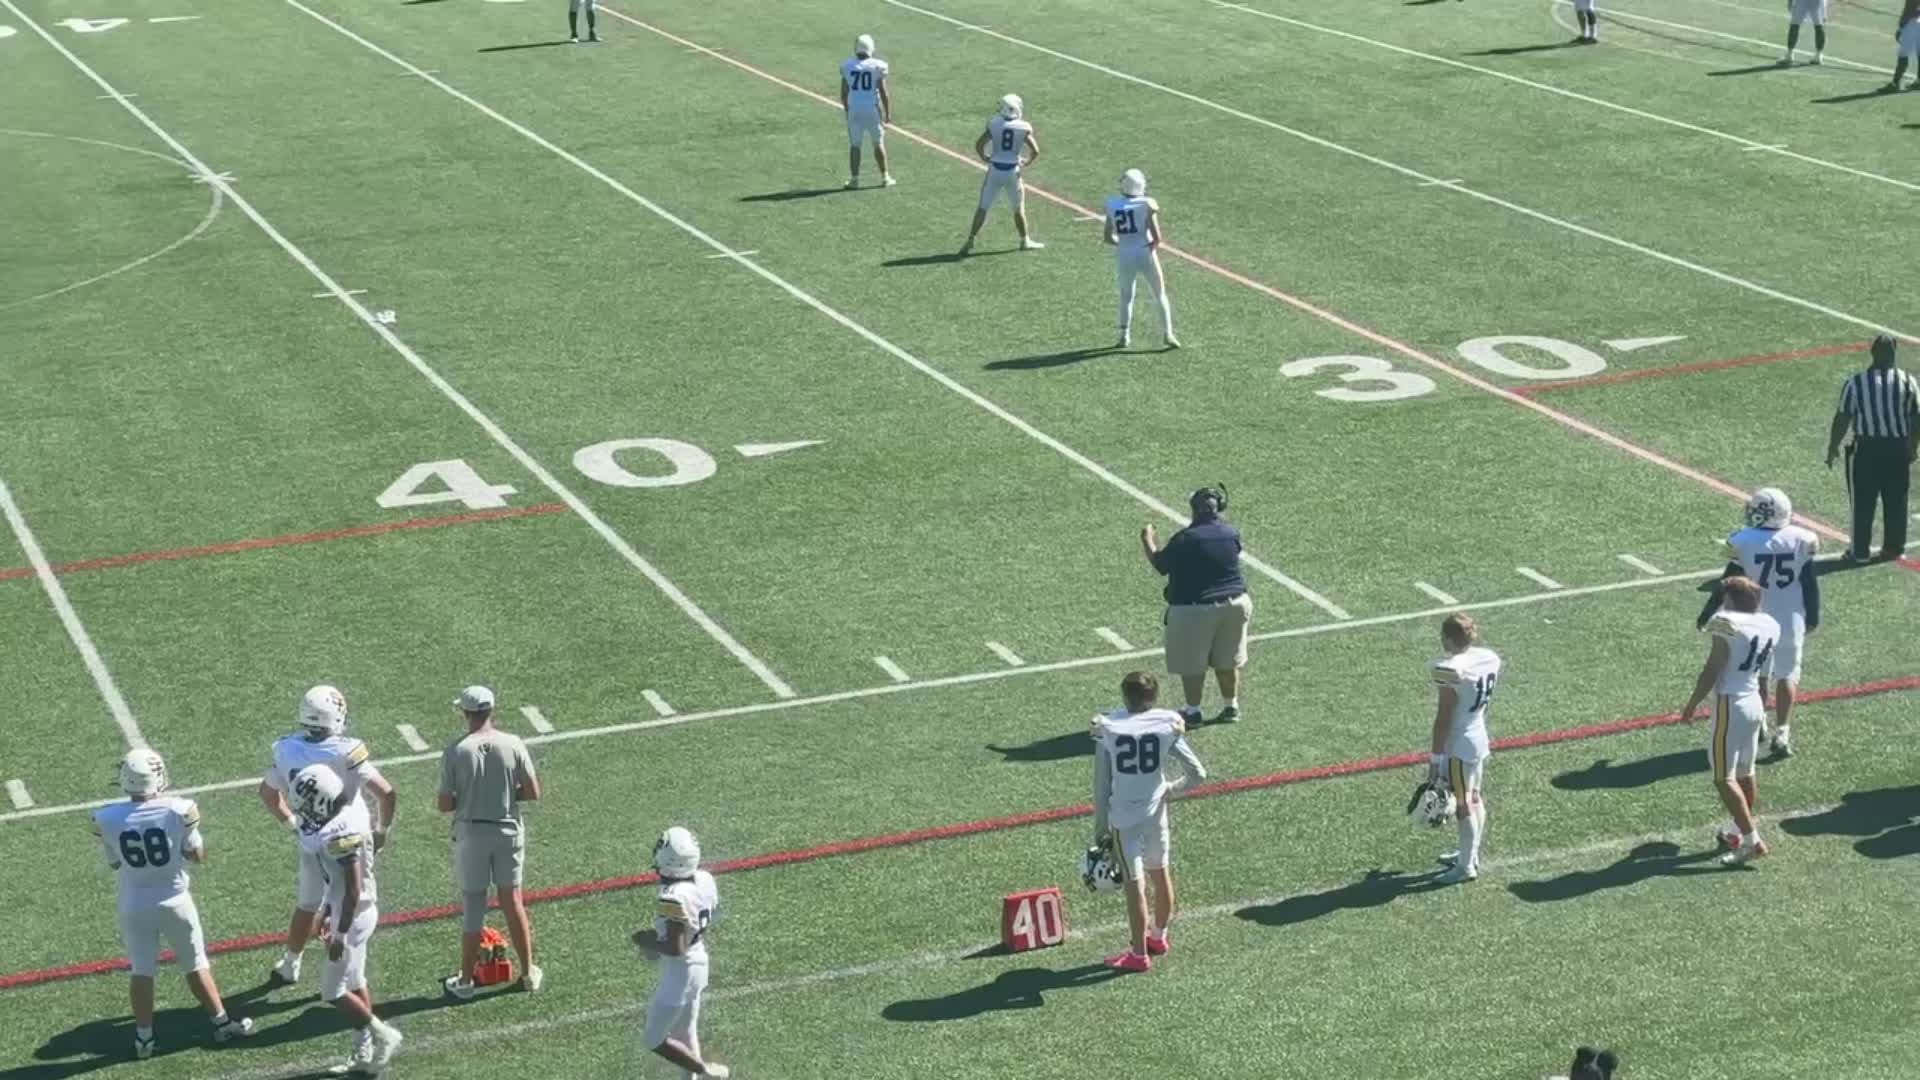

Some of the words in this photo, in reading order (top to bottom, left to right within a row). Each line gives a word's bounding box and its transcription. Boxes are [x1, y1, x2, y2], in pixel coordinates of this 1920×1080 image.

[850, 71, 872, 91] 70
[1002, 128, 1014, 151] 8
[1114, 209, 1138, 234] 21
[1279, 335, 1607, 401] 30
[376, 438, 717, 508] 40
[1754, 553, 1795, 589] 75
[1115, 733, 1160, 775] 28
[119, 828, 170, 868] 68
[1012, 893, 1063, 948] 40
